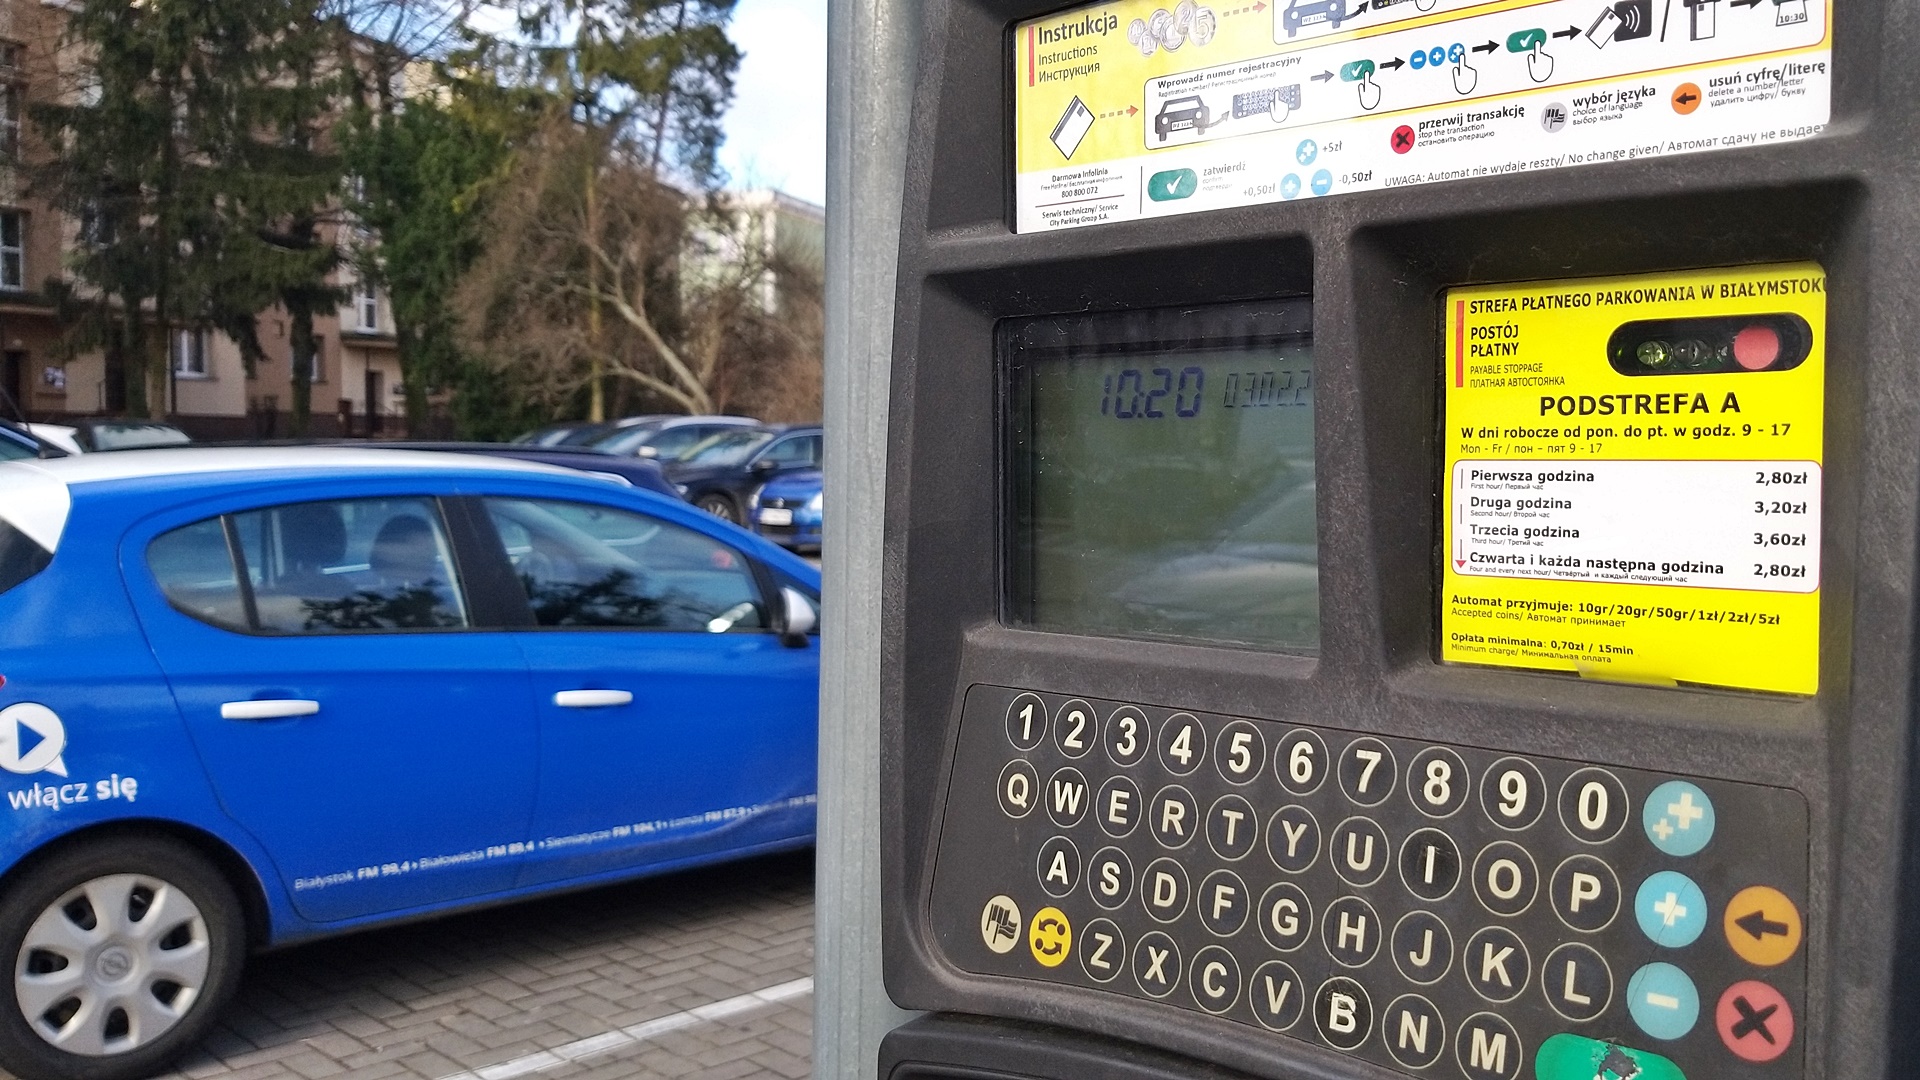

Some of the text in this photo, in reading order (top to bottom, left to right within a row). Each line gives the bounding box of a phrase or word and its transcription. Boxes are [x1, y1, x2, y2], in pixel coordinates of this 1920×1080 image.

[1780, 12, 1804, 23] 10:30
[1038, 12, 1118, 45] Instrukcja
[1038, 45, 1098, 66] Instructions
[1038, 62, 1100, 82] Инструкция
[1158, 73, 1204, 89] Wprowadź
[1207, 69, 1236, 80] numer
[1239, 56, 1301, 73] rejestracyjny
[1709, 62, 1826, 88] usuń cyfrę/literę
[1708, 77, 1804, 98] delete number/letter
[1573, 85, 1656, 109] wybór języka
[1573, 101, 1643, 117] choice language
[1419, 104, 1525, 132] przerwij transakcję
[1418, 123, 1485, 140] stop the transaction
[1322, 140, 1343, 153] +5zł
[1667, 130, 1776, 152] Автомат сдачу не
[1203, 161, 1247, 177] zatwierdź
[1384, 141, 1664, 187] UWAGA: Automat nie wydaje reszty/ No change given/
[1052, 171, 1082, 183] Darmowa
[1082, 168, 1109, 179] Infolinia
[1339, 170, 1373, 186] -0,50zł
[1061, 186, 1099, 198] 800 800 072
[1243, 182, 1276, 198] +0,50zł
[1042, 203, 1119, 220] Serwis techniczny/ Service
[1050, 216, 1080, 228] City Parking
[1470, 299, 1518, 315] STREFA
[1522, 292, 1592, 311] PŁATNEGO
[1596, 285, 1696, 306] PARKOWANIA
[1700, 284, 1715, 300] W
[1470, 320, 1519, 340] POSTÓJ
[1470, 341, 1520, 358] PŁATNY
[1470, 362, 1543, 375] PAYABLE STOPPAGE
[1470, 376, 1566, 389] ПЛАТНАЯ АВТОСТОЯНКА
[1540, 391, 1742, 416] PODSTREFA A
[1461, 423, 1791, 440] W dni robocze od pon. do pt. w godz. 9 17
[1460, 443, 1503, 454] Mon Fr
[1514, 443, 1603, 454] пон пят 9 17
[1471, 469, 1595, 485] Pierwsza godzina
[1755, 471, 1808, 487] 2,80zł
[1485, 482, 1504, 491] hour/
[1470, 496, 1572, 511] Druga godzina
[1754, 501, 1807, 516] 3,20zł
[1470, 510, 1512, 518] Second hour/
[1514, 511, 1537, 519] Второй
[1469, 524, 1580, 540] Trzecia godzina
[1753, 532, 1807, 548] 3,60zł
[1471, 537, 1487, 545] Third
[1469, 551, 1724, 575] Czwarta każda następna godzina
[1754, 563, 1806, 579] 2,80zł
[1451, 607, 1524, 622] Accepted coins/
[1452, 594, 1780, 626] Automat przyjmuje: 10gr/20gr/50gr/1zł/2zł/5zł
[1527, 613, 1626, 628] Автомат принимает
[1451, 632, 1634, 656] Opłata minimalna: 0,70zł 15min
[1451, 643, 1519, 658] Minimum charge/
[1522, 650, 1612, 664] Минимальная оплата
[1019, 704, 1608, 831] 1 2 3 4 5 6 7 8 9 0
[8, 773, 138, 811] włącz się
[1007, 773, 1601, 912] Q W E R T Y U I O P
[357, 866, 379, 881] FM
[486, 844, 507, 860] FM
[613, 824, 632, 837] FM
[1046, 850, 1591, 1005] A S D F G H J K L
[1090, 933, 1507, 1074] Z X C V B N M
